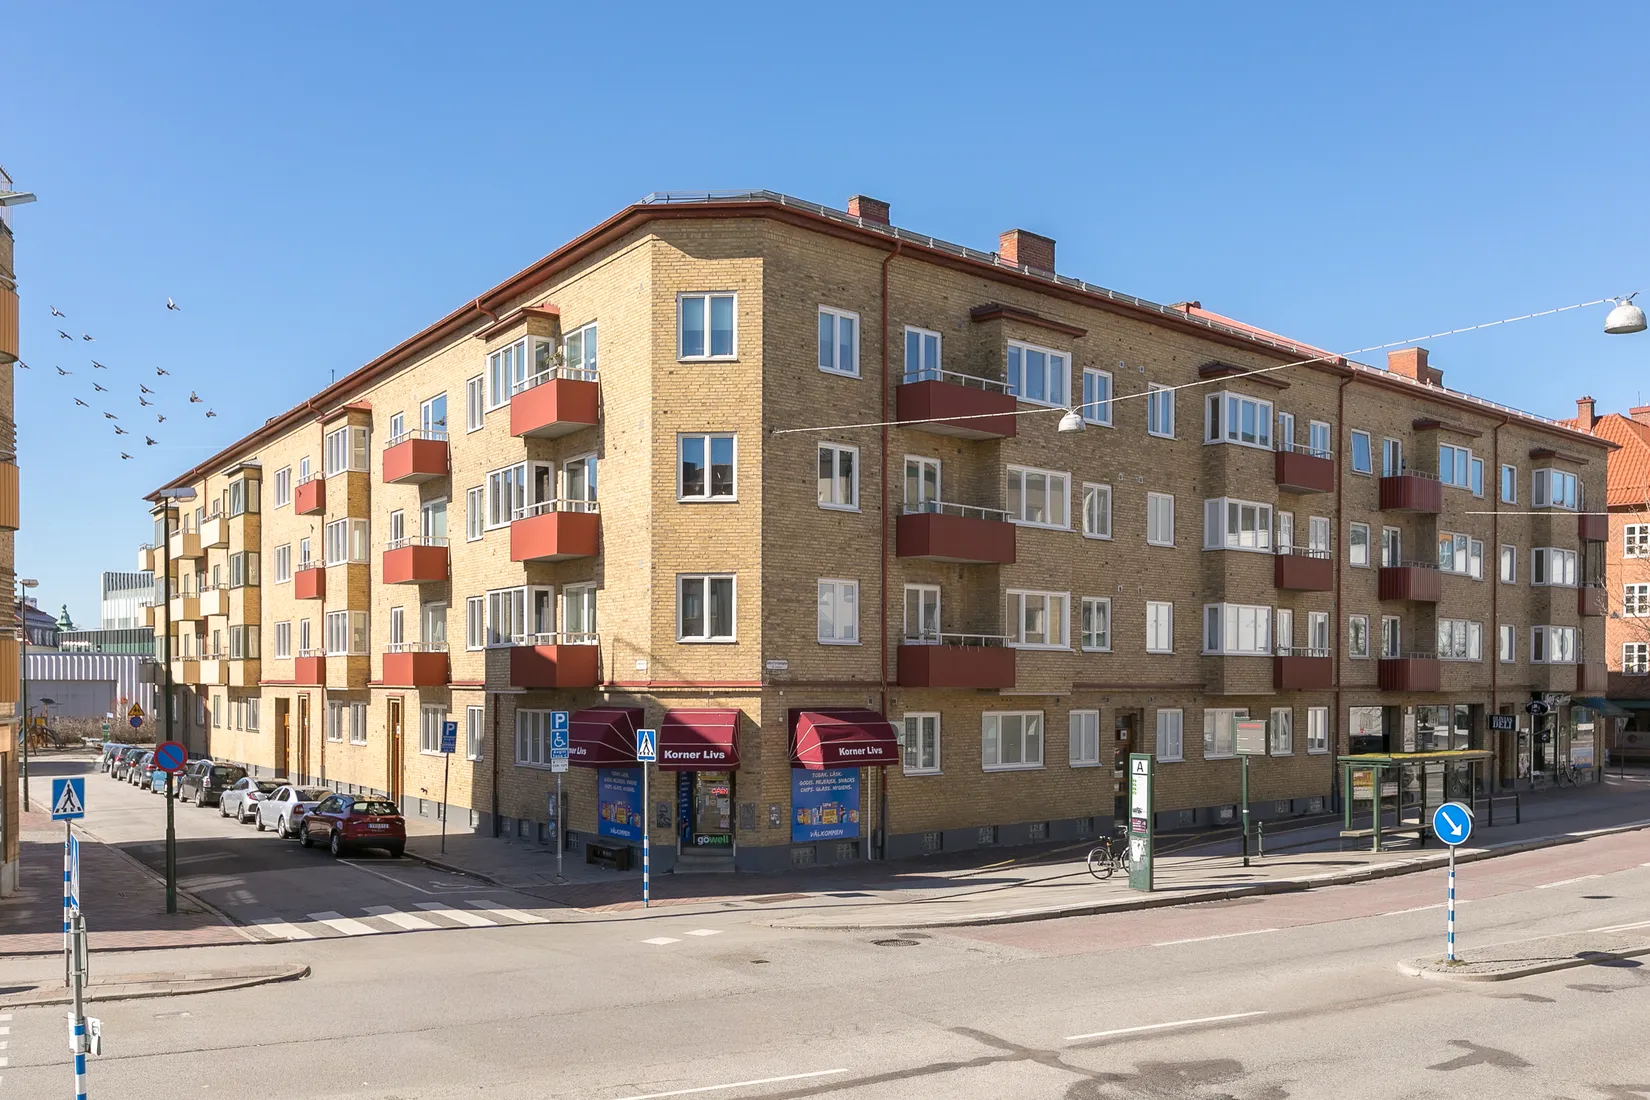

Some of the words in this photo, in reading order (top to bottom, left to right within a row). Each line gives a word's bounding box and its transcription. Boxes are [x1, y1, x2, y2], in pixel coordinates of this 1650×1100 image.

[555, 713, 566, 729] P
[1492, 720, 1512, 730] DELI
[446, 723, 455, 736] P
[576, 746, 587, 756] Livs
[664, 750, 701, 759] Korner
[703, 750, 725, 759] Livs
[838, 747, 866, 756] Korner
[866, 746, 883, 755] Livs
[1136, 761, 1144, 773] A
[711, 787, 729, 795] OPEN
[809, 829, 844, 838] VÄLKOMMEN
[697, 835, 729, 845] gowell
